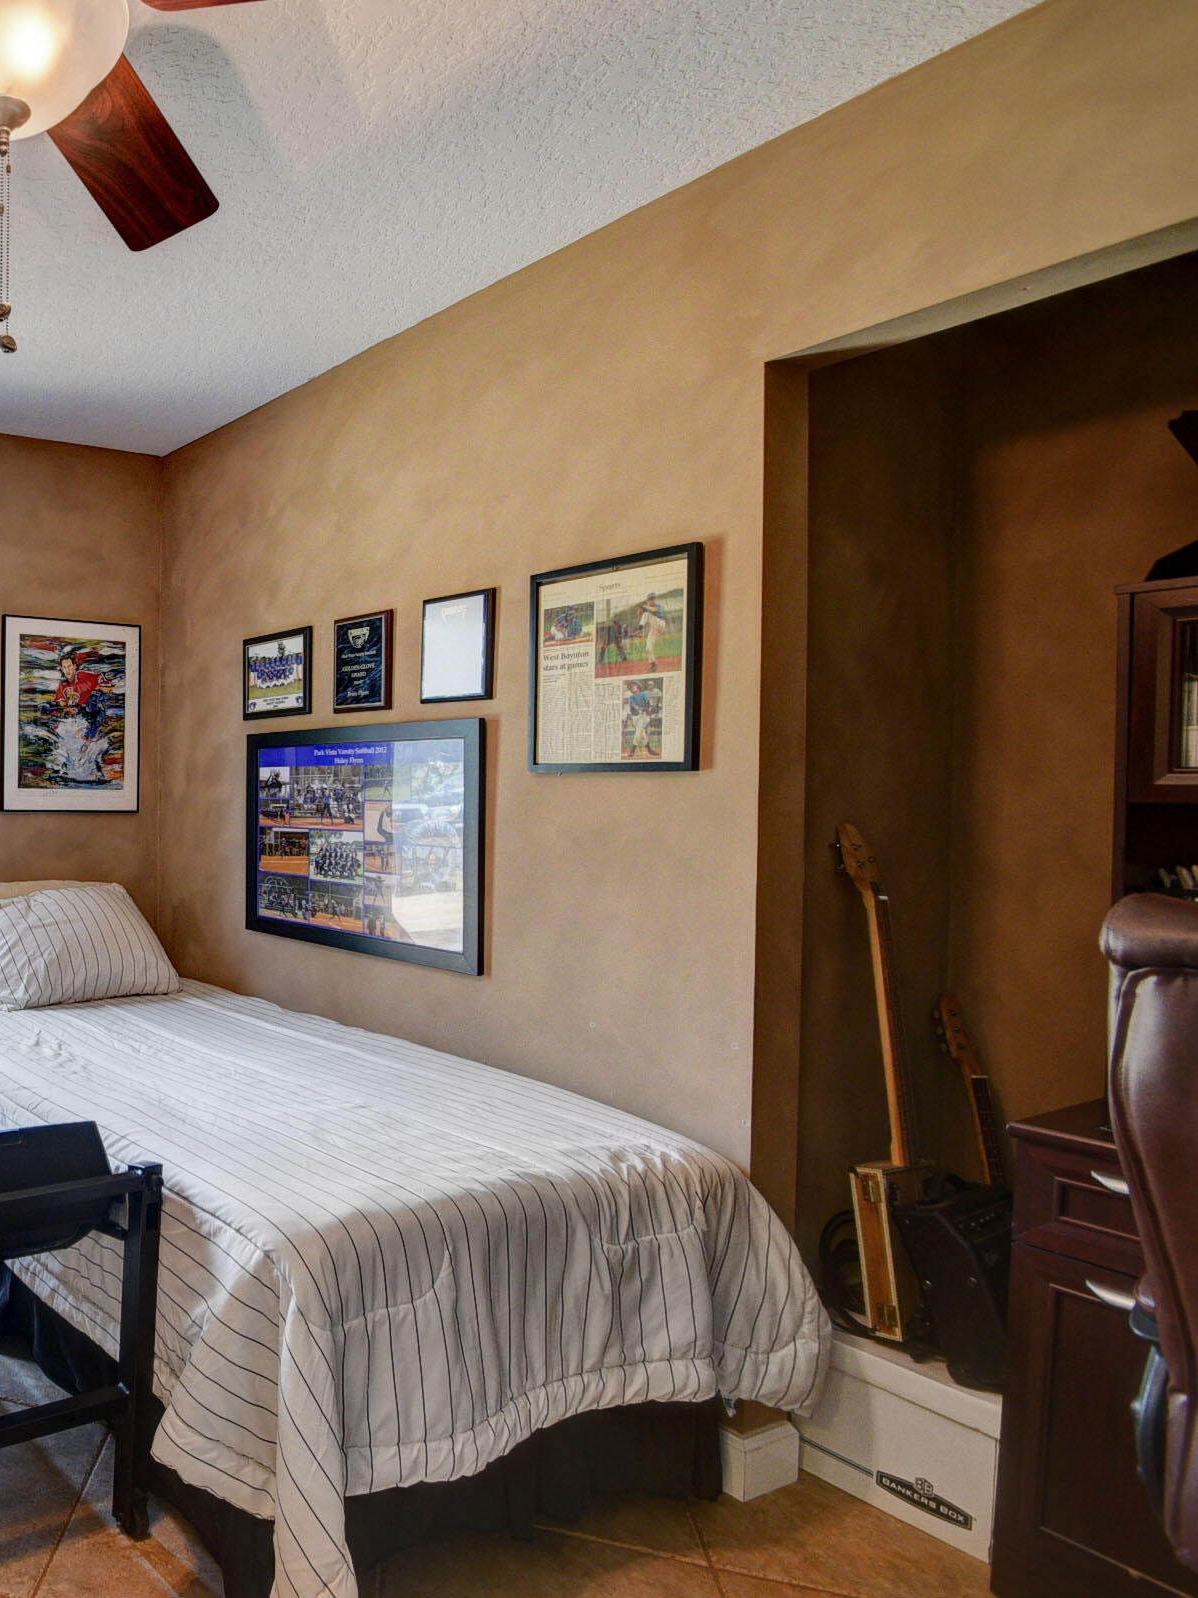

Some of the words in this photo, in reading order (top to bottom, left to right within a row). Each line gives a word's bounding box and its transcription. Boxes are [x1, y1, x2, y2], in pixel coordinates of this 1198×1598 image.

[561, 651, 590, 661] Boynton
[567, 661, 589, 671] games
[882, 1477, 937, 1510] BANKERS
[939, 1504, 966, 1524] BOX
